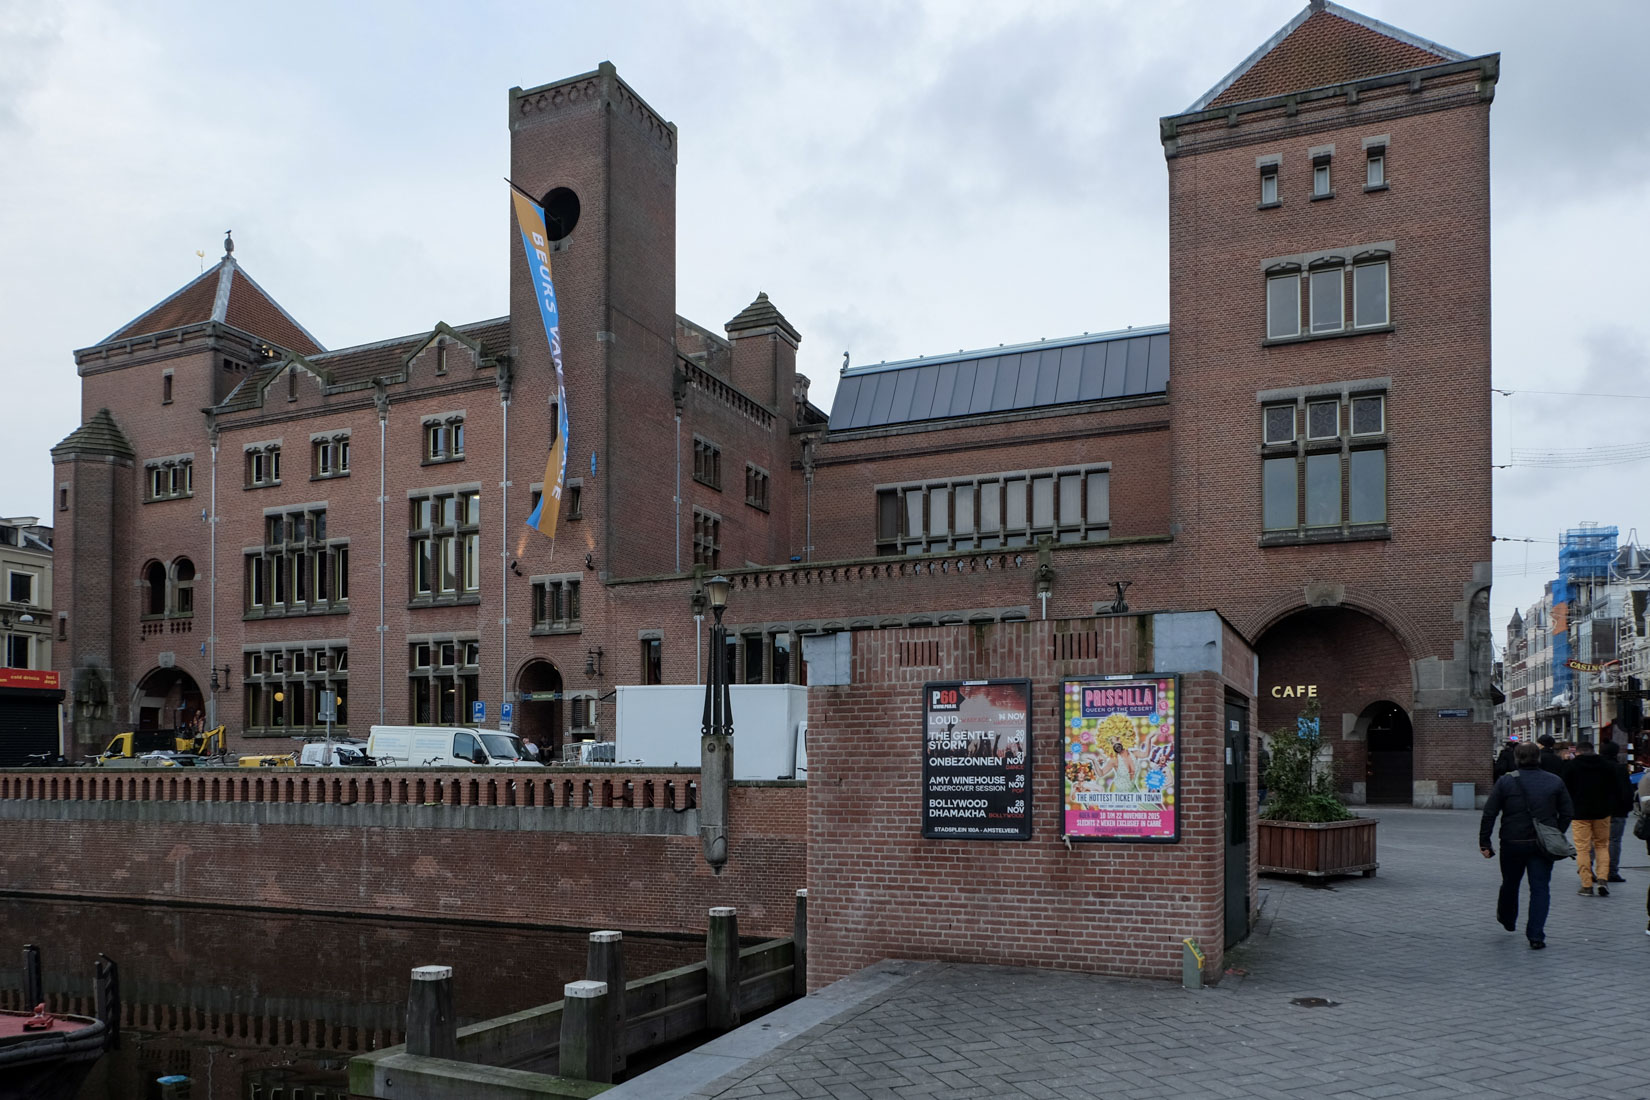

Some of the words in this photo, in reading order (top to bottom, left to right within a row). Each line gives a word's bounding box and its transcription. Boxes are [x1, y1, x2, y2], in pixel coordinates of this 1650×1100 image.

[531, 232, 556, 314] BEURS
[550, 326, 564, 376] VAN
[1570, 662, 1604, 670] CASINO
[1272, 685, 1317, 698] CAFE
[932, 690, 957, 704] P60
[1085, 688, 1153, 707] PRISCILLA
[476, 702, 483, 712] P
[503, 704, 510, 714] P
[929, 716, 958, 724] LOUD
[929, 732, 950, 740] THE
[952, 730, 995, 740] GENTLE
[928, 740, 967, 750] STORM
[929, 757, 1002, 766] ONBEZONNEN
[952, 776, 1006, 784] WINEHOUSE
[1114, 794, 1134, 802] TICKET
[1144, 793, 1162, 801] TOWN!
[930, 800, 988, 808] BOLLYWOOD
[930, 809, 986, 818] DHAMAKHA
